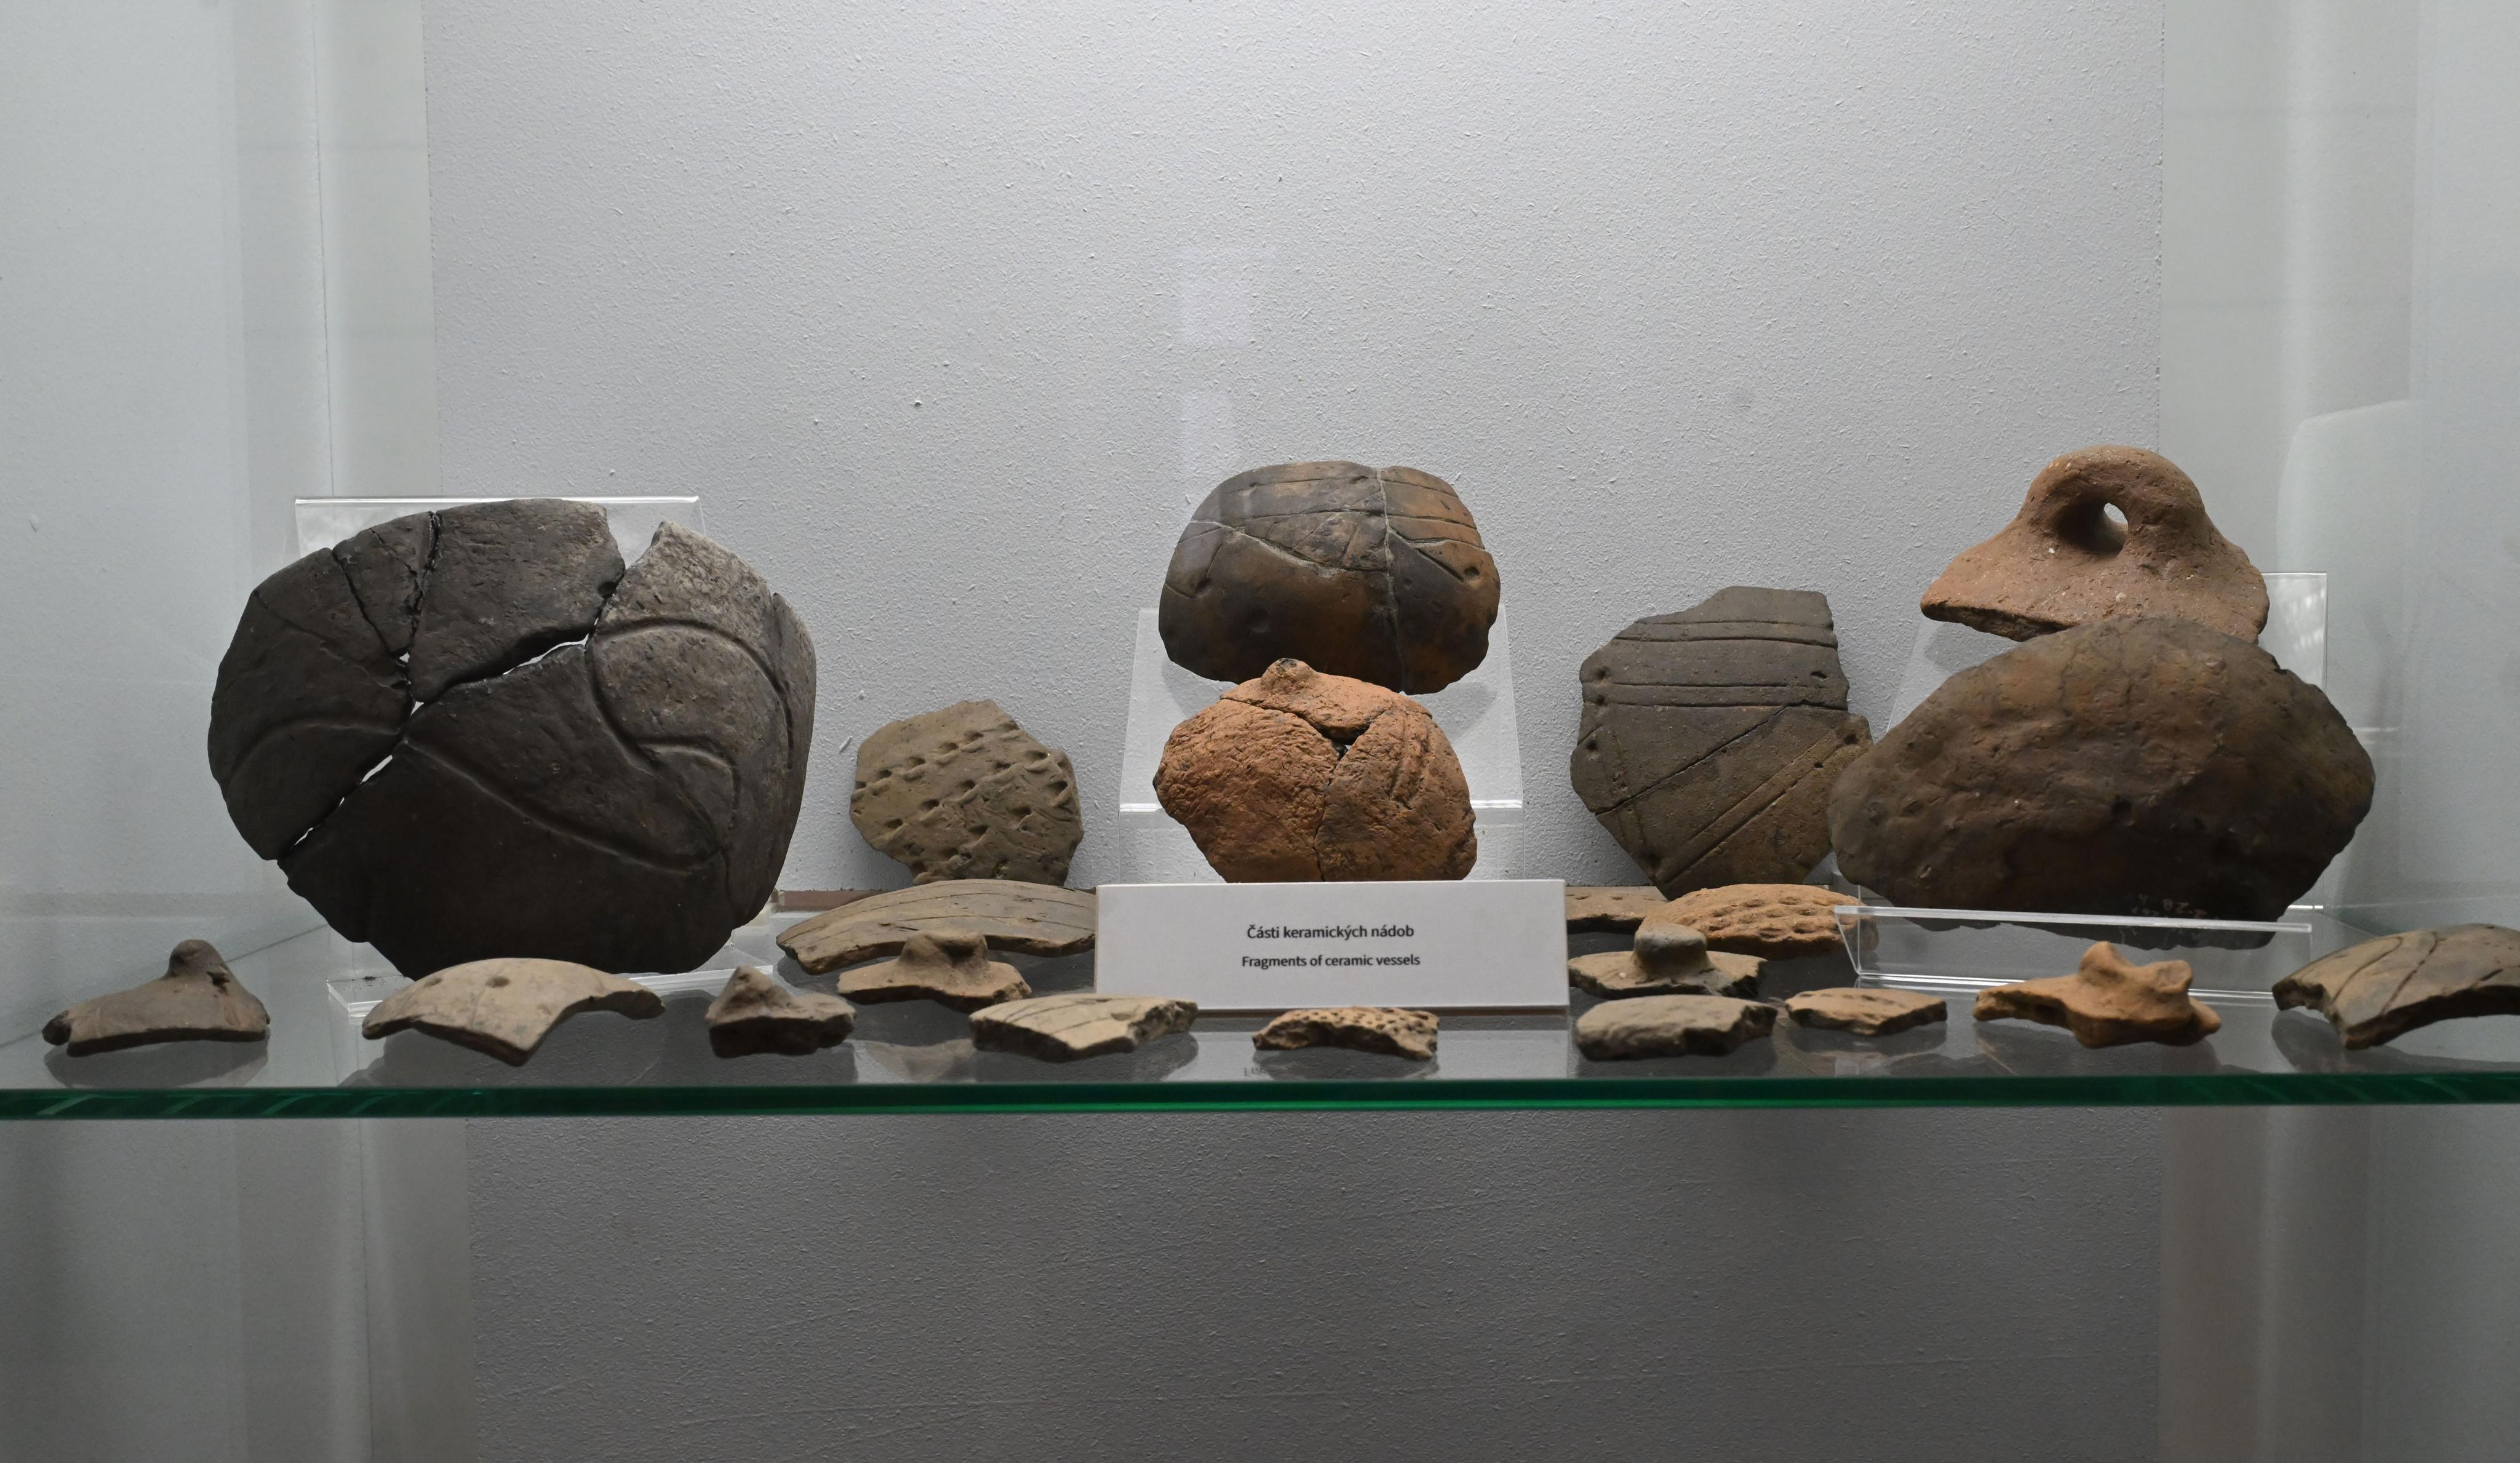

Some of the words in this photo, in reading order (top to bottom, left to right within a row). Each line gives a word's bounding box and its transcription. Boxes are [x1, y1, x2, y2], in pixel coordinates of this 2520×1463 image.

[1246, 924, 1280, 939] Části
[1283, 925, 1368, 941] keramických
[1371, 924, 1414, 938] nádob
[1242, 955, 1307, 970] Fragments
[1309, 954, 1323, 967] of
[1325, 954, 1373, 967] ceramic
[1376, 954, 1421, 966] vessels
